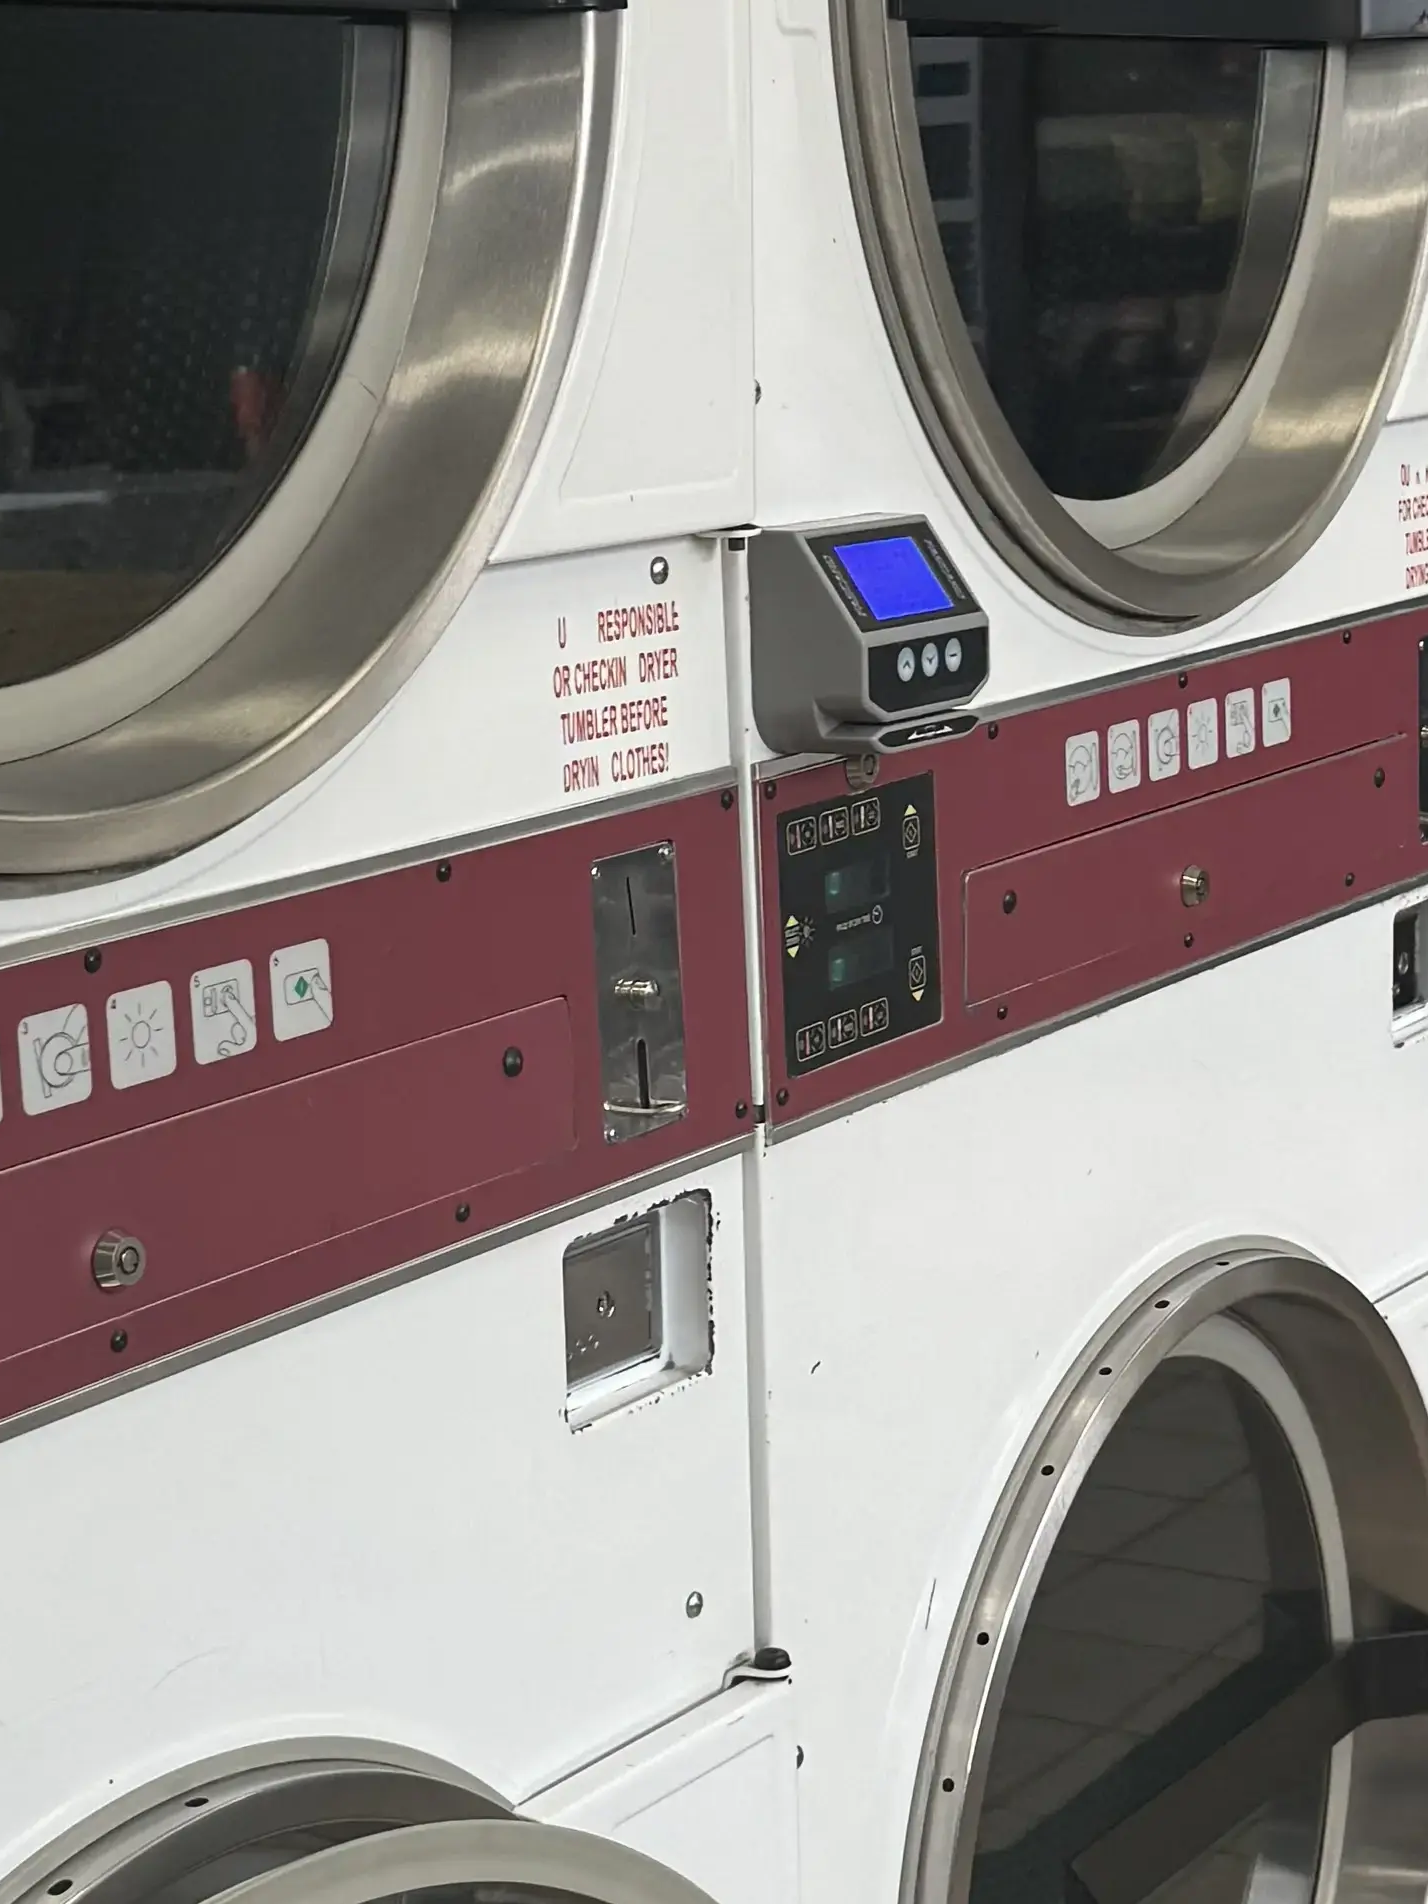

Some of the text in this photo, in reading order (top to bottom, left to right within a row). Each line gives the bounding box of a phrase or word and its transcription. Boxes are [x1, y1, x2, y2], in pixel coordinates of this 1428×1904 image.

[557, 600, 680, 649] U RESPONSIBLE
[553, 647, 679, 698] OR CHECKIN DRYER
[560, 695, 669, 745] TUMBLER BEFORE
[563, 741, 670, 793] DRYIN CLOTHES!
[193, 975, 201, 989] 5
[21, 1022, 30, 1036] 3
